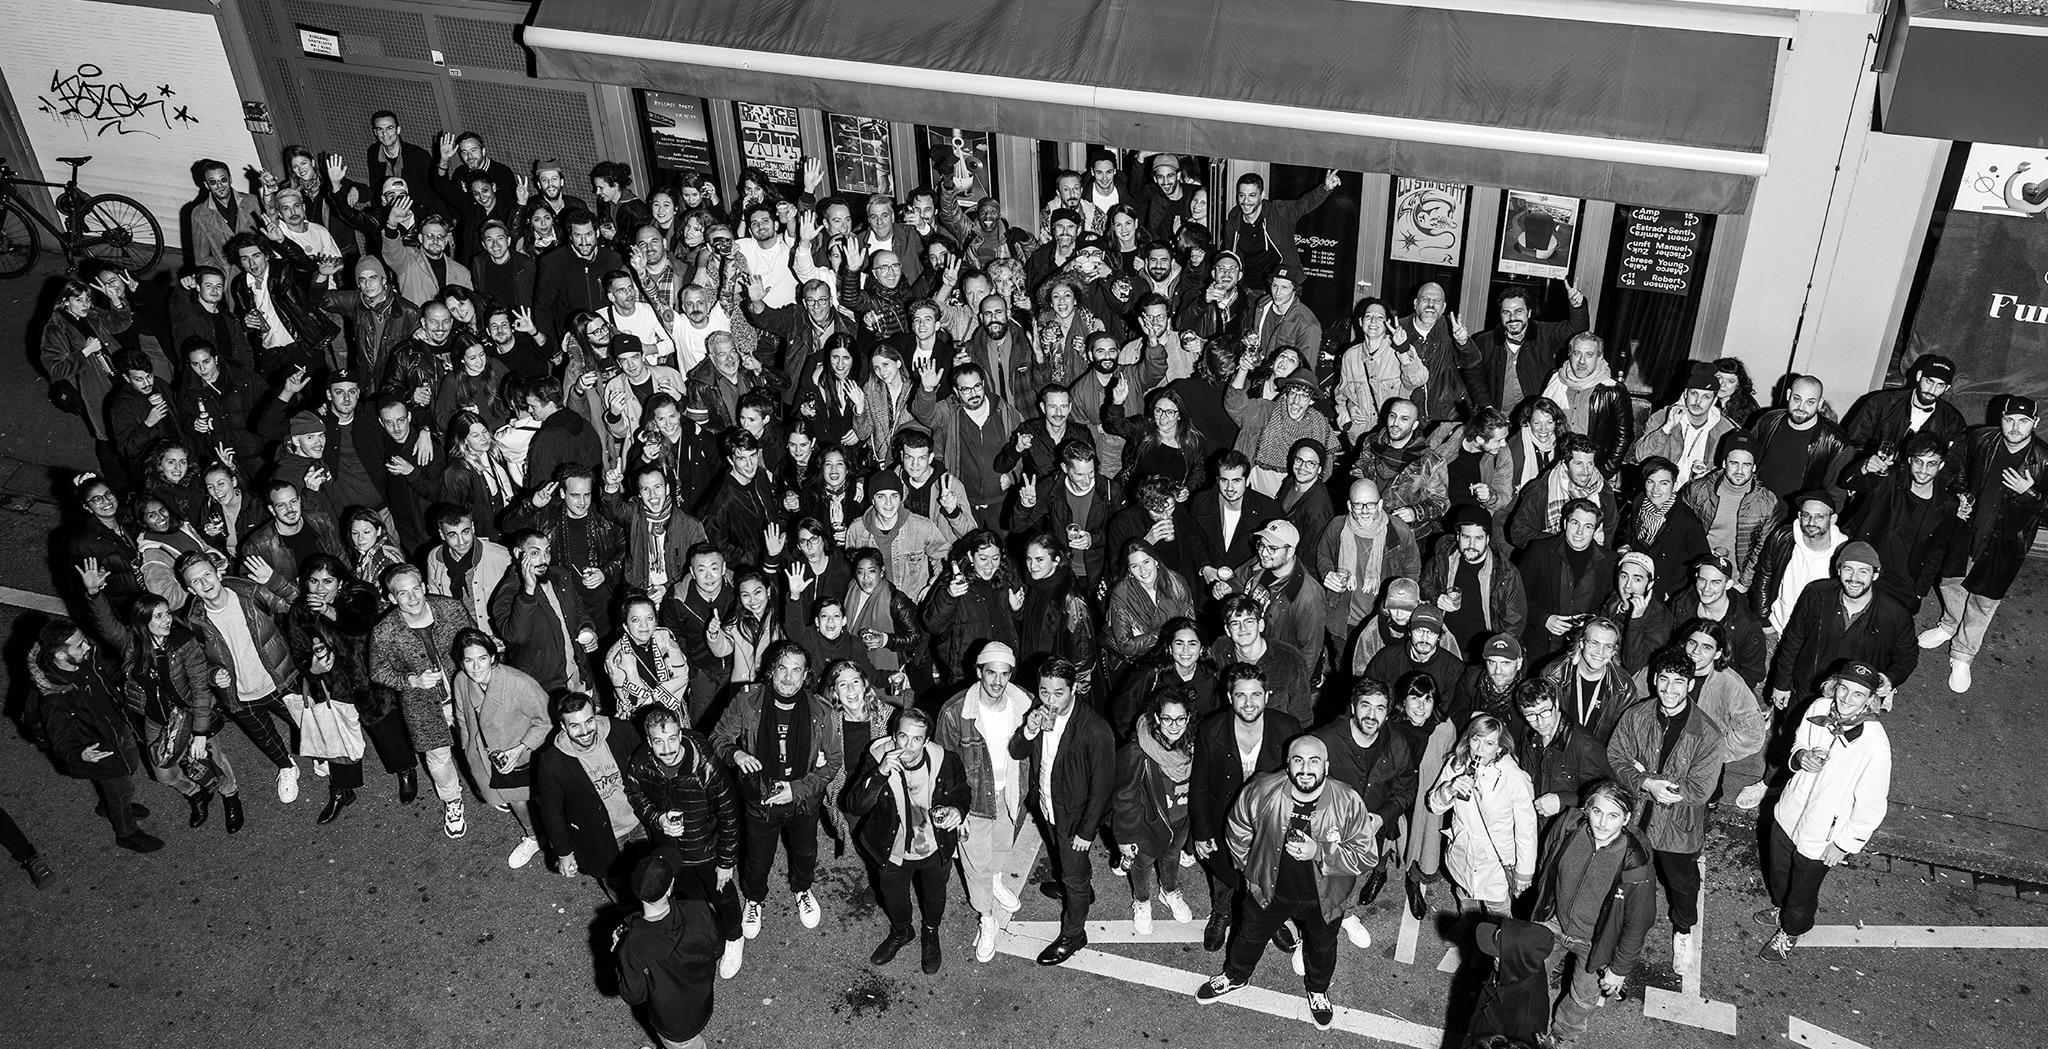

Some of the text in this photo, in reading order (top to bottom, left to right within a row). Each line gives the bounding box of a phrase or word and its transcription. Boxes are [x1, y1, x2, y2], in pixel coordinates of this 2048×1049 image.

[741, 104, 797, 119] DANCE
[741, 111, 798, 127] MACHINE
[1639, 207, 1660, 217] Amp
[1637, 214, 1659, 223] Amp
[1635, 223, 1691, 236] Estrada Senti
[1632, 240, 1688, 252] unft Manuel
[1630, 255, 1685, 270] brese Young
[1651, 274, 1681, 284] Robert
